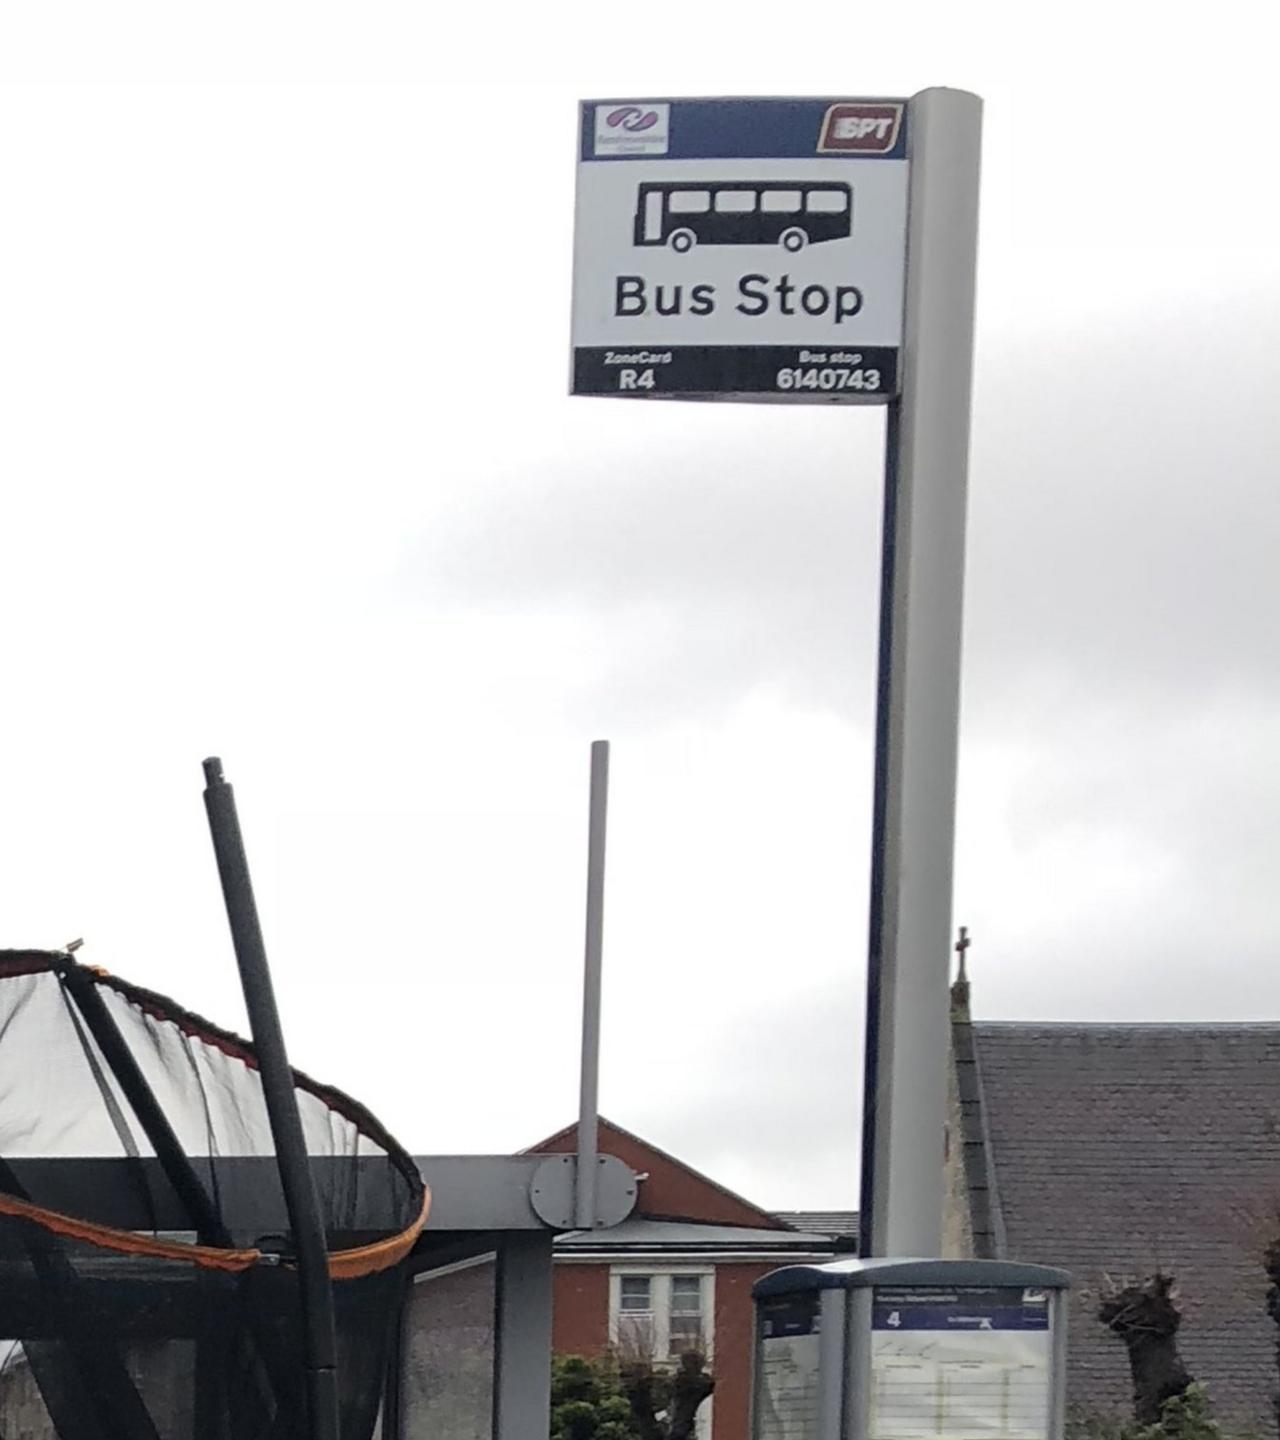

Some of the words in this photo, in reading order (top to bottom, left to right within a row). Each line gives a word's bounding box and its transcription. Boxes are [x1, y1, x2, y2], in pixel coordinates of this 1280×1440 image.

[614, 275, 716, 317] Bus
[735, 273, 863, 325] Stop
[798, 350, 828, 364] Bus
[830, 350, 863, 366] stop
[619, 368, 656, 390] R4
[776, 367, 881, 390] 6140743
[886, 1311, 902, 1328] 4
